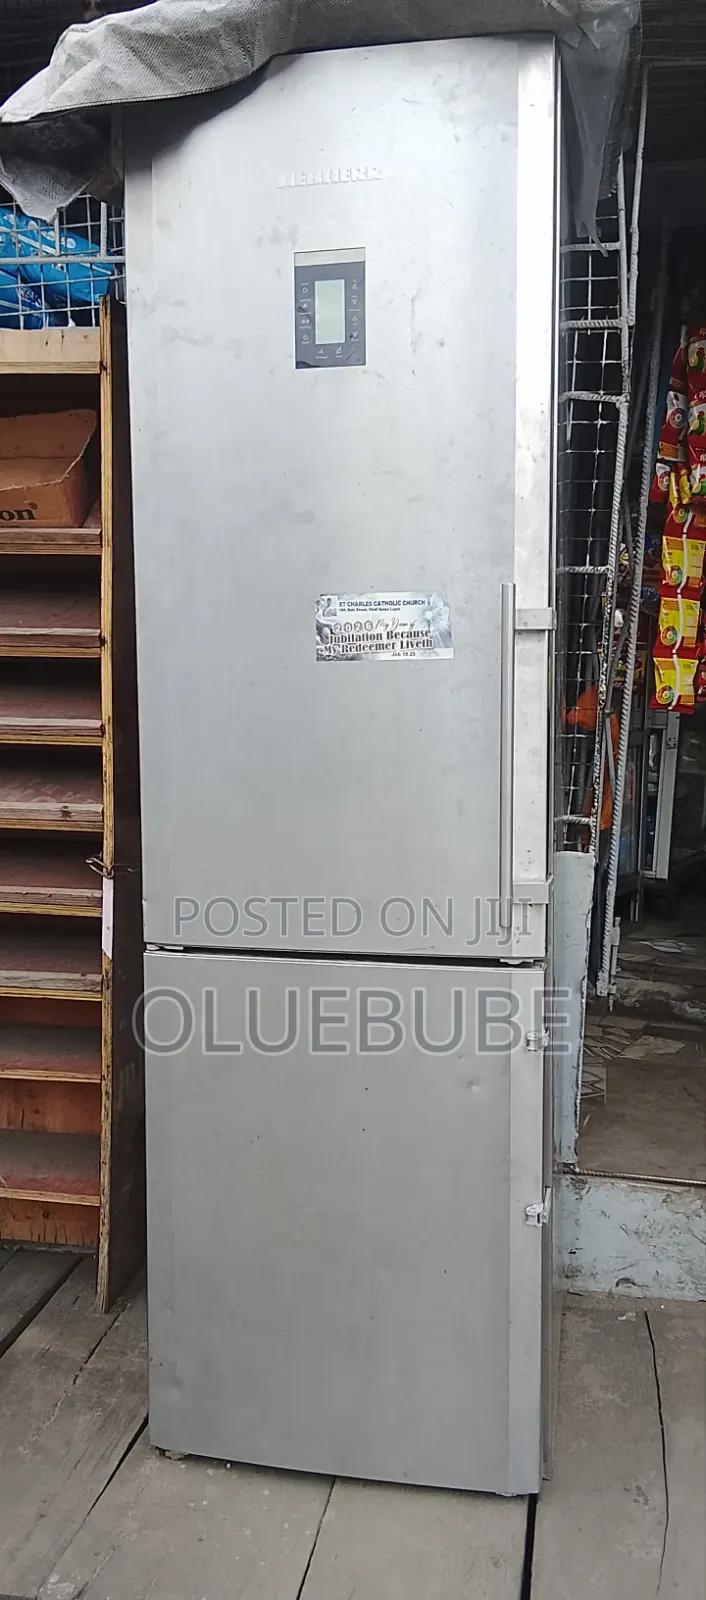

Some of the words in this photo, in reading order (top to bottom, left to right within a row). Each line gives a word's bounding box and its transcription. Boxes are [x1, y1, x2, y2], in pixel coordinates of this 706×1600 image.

[373, 599, 402, 607] CATHOLIC
[333, 620, 374, 633] 2026
[329, 631, 383, 645] Jubilation
[386, 629, 431, 640] Because
[323, 645, 340, 655] My
[341, 641, 397, 654] Redeemer
[400, 639, 433, 649] Liveth
